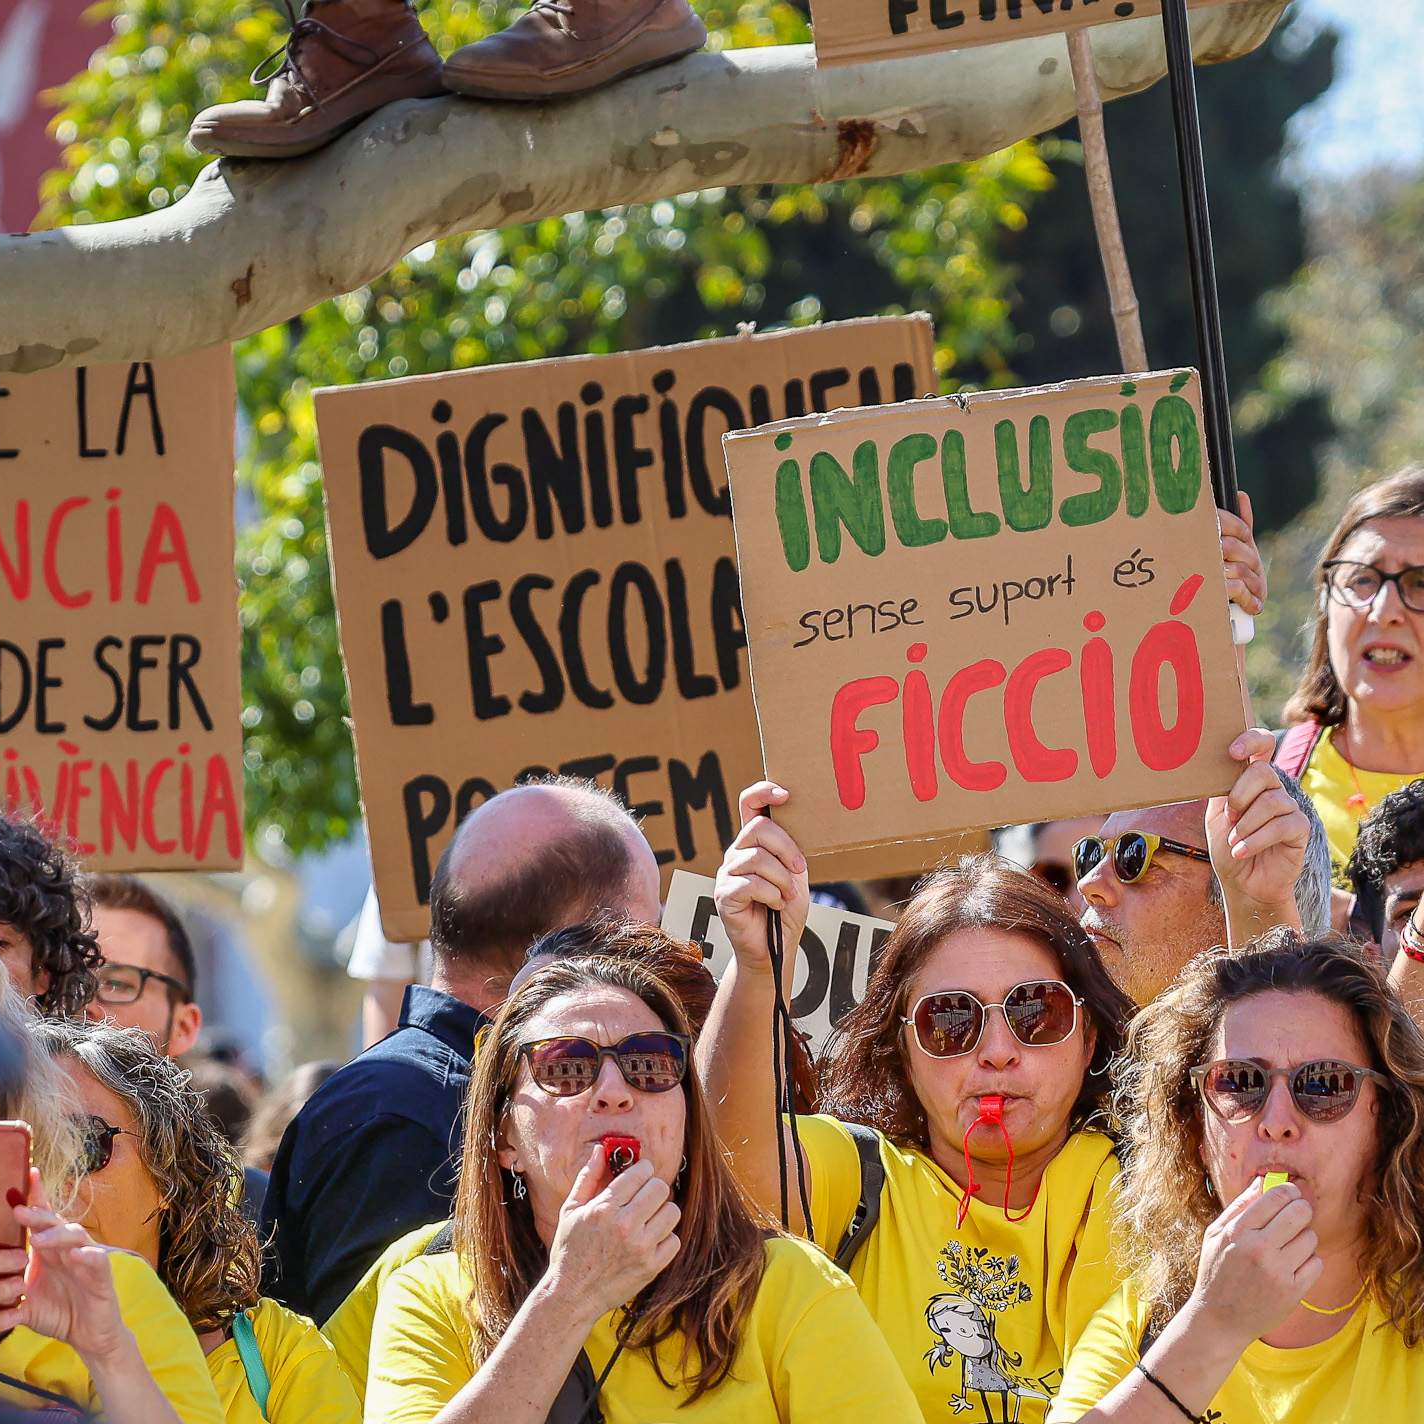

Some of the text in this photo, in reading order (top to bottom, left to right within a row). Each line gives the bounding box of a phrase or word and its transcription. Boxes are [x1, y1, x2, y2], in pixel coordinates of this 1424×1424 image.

[78, 361, 166, 459] LA
[380, 555, 748, 727] L'ESCOLA
[794, 548, 1156, 648] sense suport és
[83, 634, 215, 732] SER
